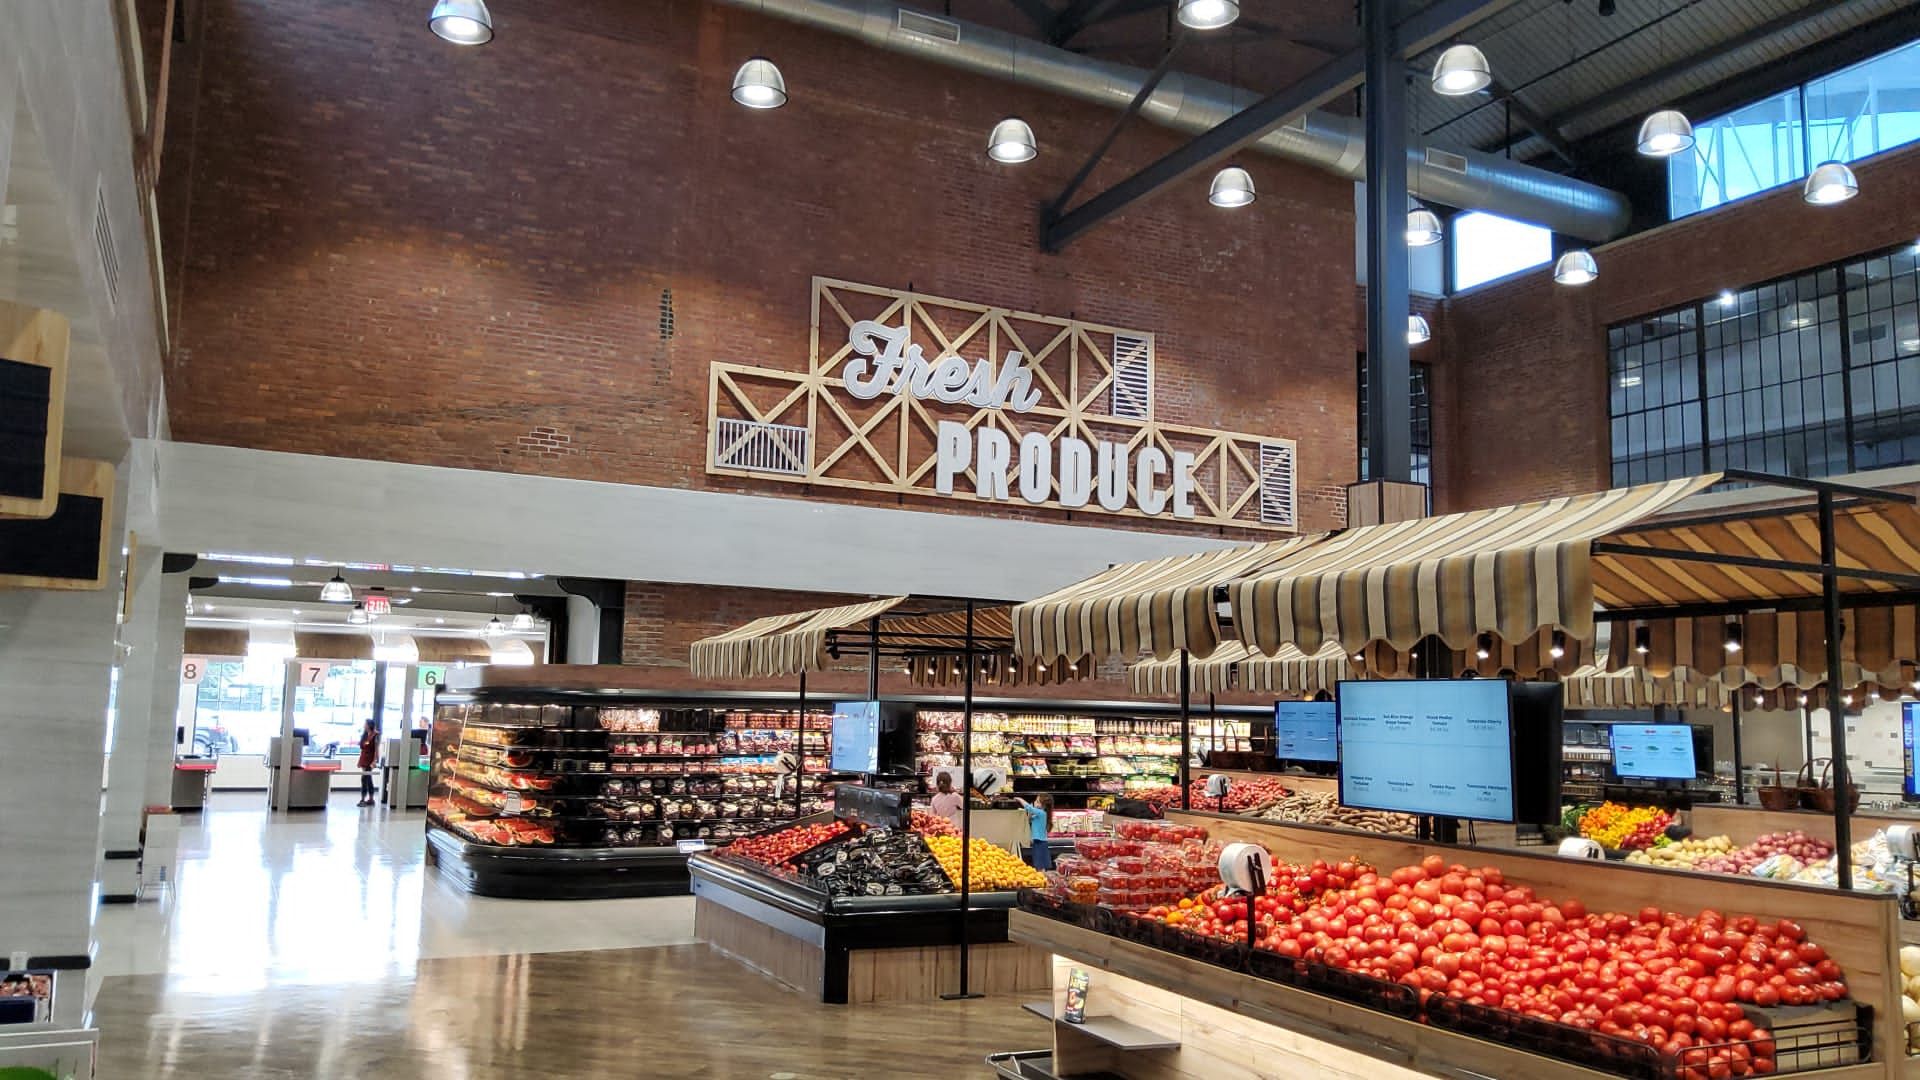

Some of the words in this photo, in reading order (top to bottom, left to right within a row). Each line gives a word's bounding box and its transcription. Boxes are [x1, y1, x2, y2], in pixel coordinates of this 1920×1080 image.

[843, 320, 1042, 413] Fresh
[936, 420, 1195, 519] PRODUCE
[184, 664, 196, 679] 8
[309, 667, 321, 683] 7
[425, 671, 437, 686] 6
